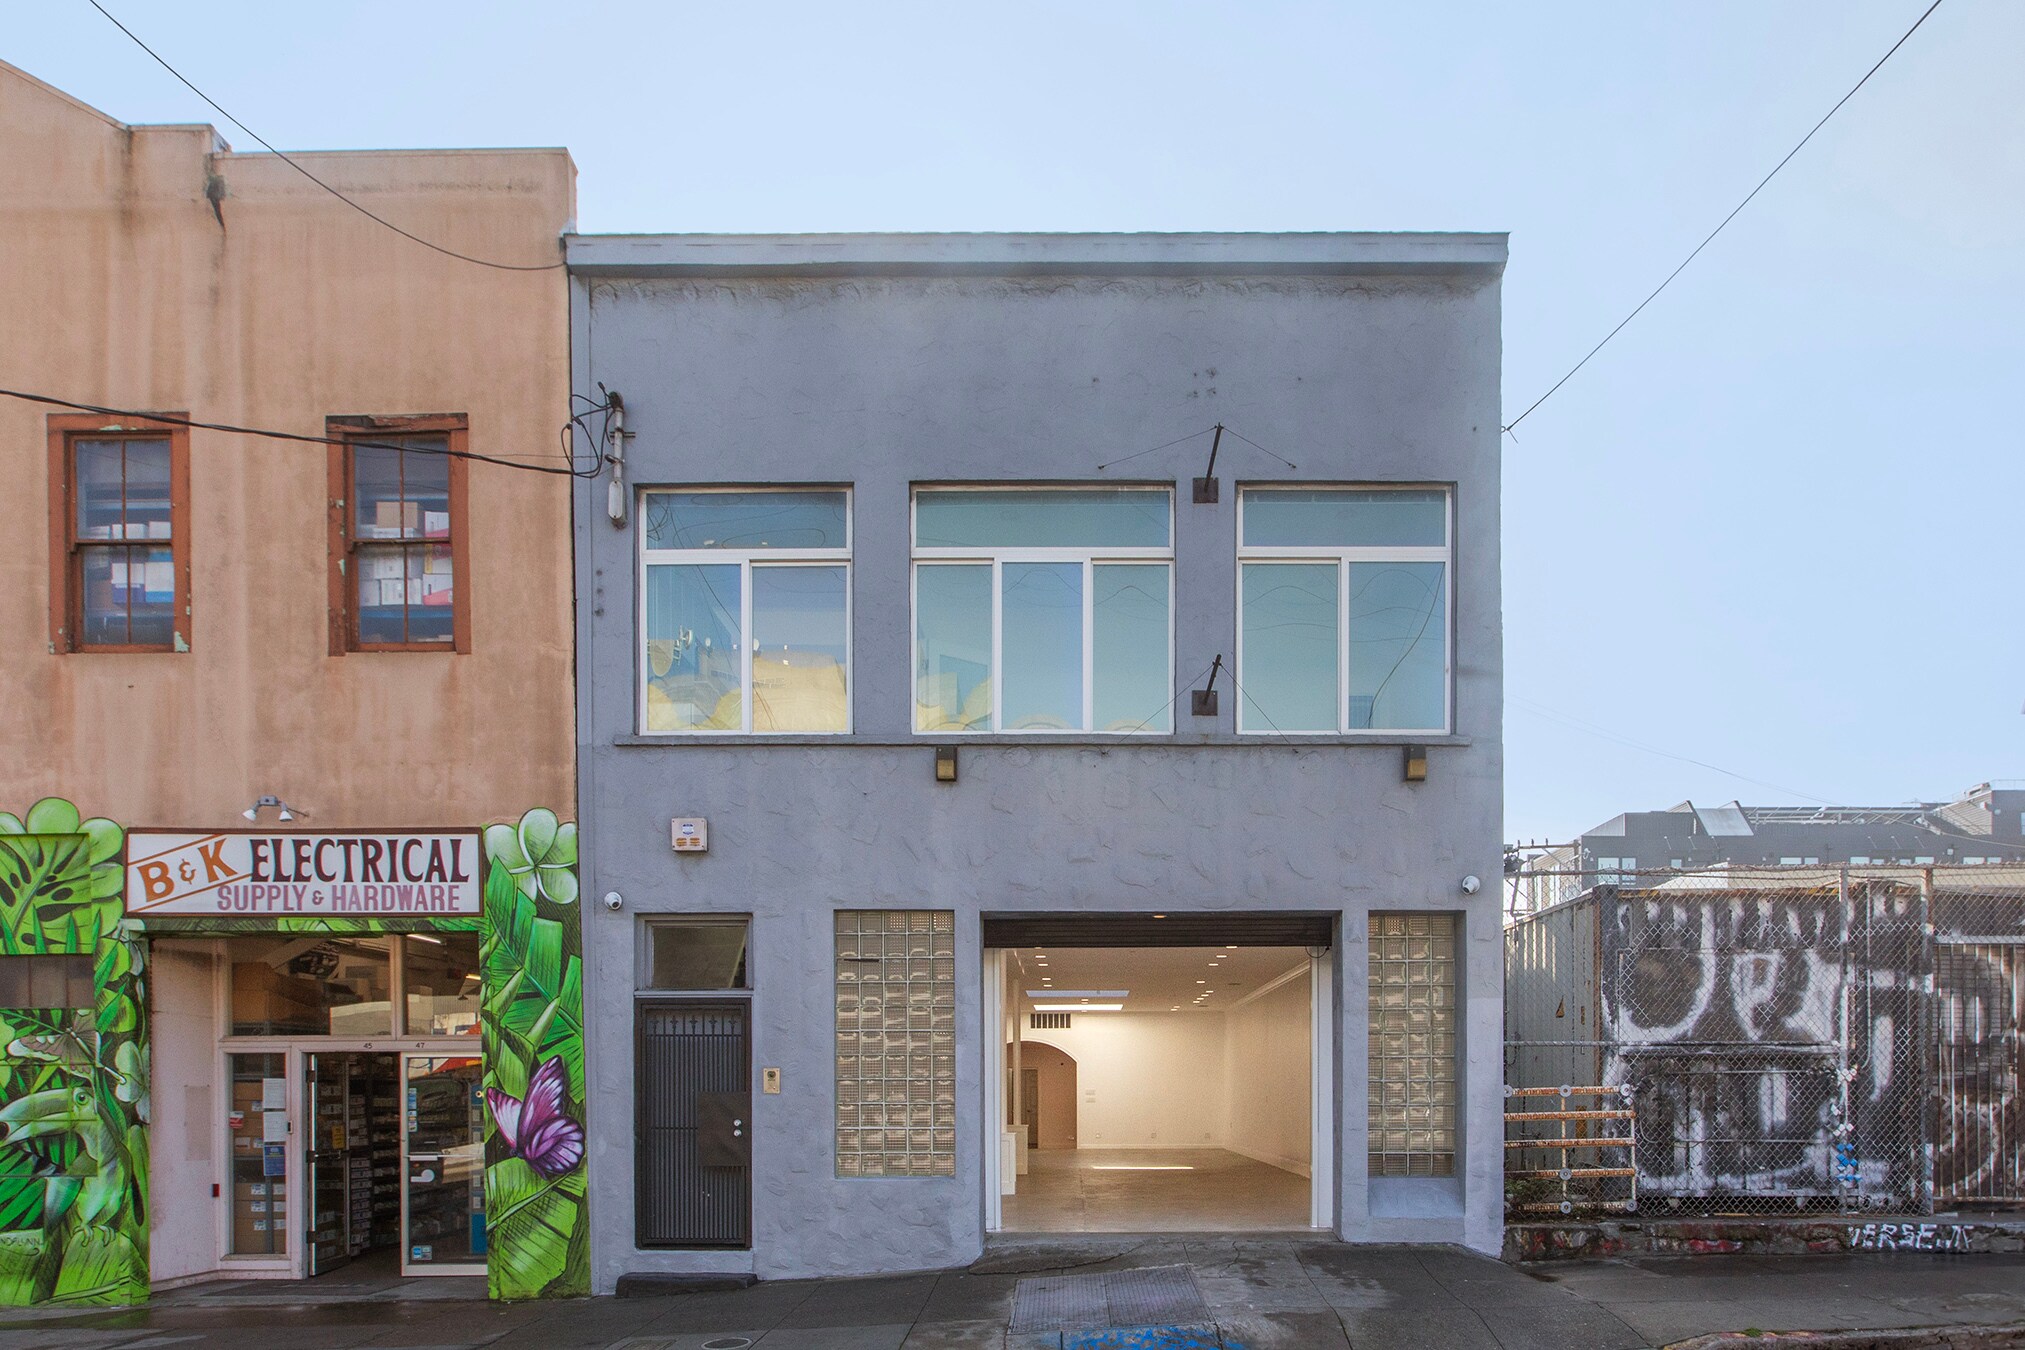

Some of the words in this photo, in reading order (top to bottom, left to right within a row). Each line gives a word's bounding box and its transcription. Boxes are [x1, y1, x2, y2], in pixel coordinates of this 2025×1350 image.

[249, 838, 470, 883] ELECTRICAL
[217, 884, 306, 912] SUPPLY
[331, 884, 460, 912] HARDWARE
[363, 1042, 373, 1050] 45
